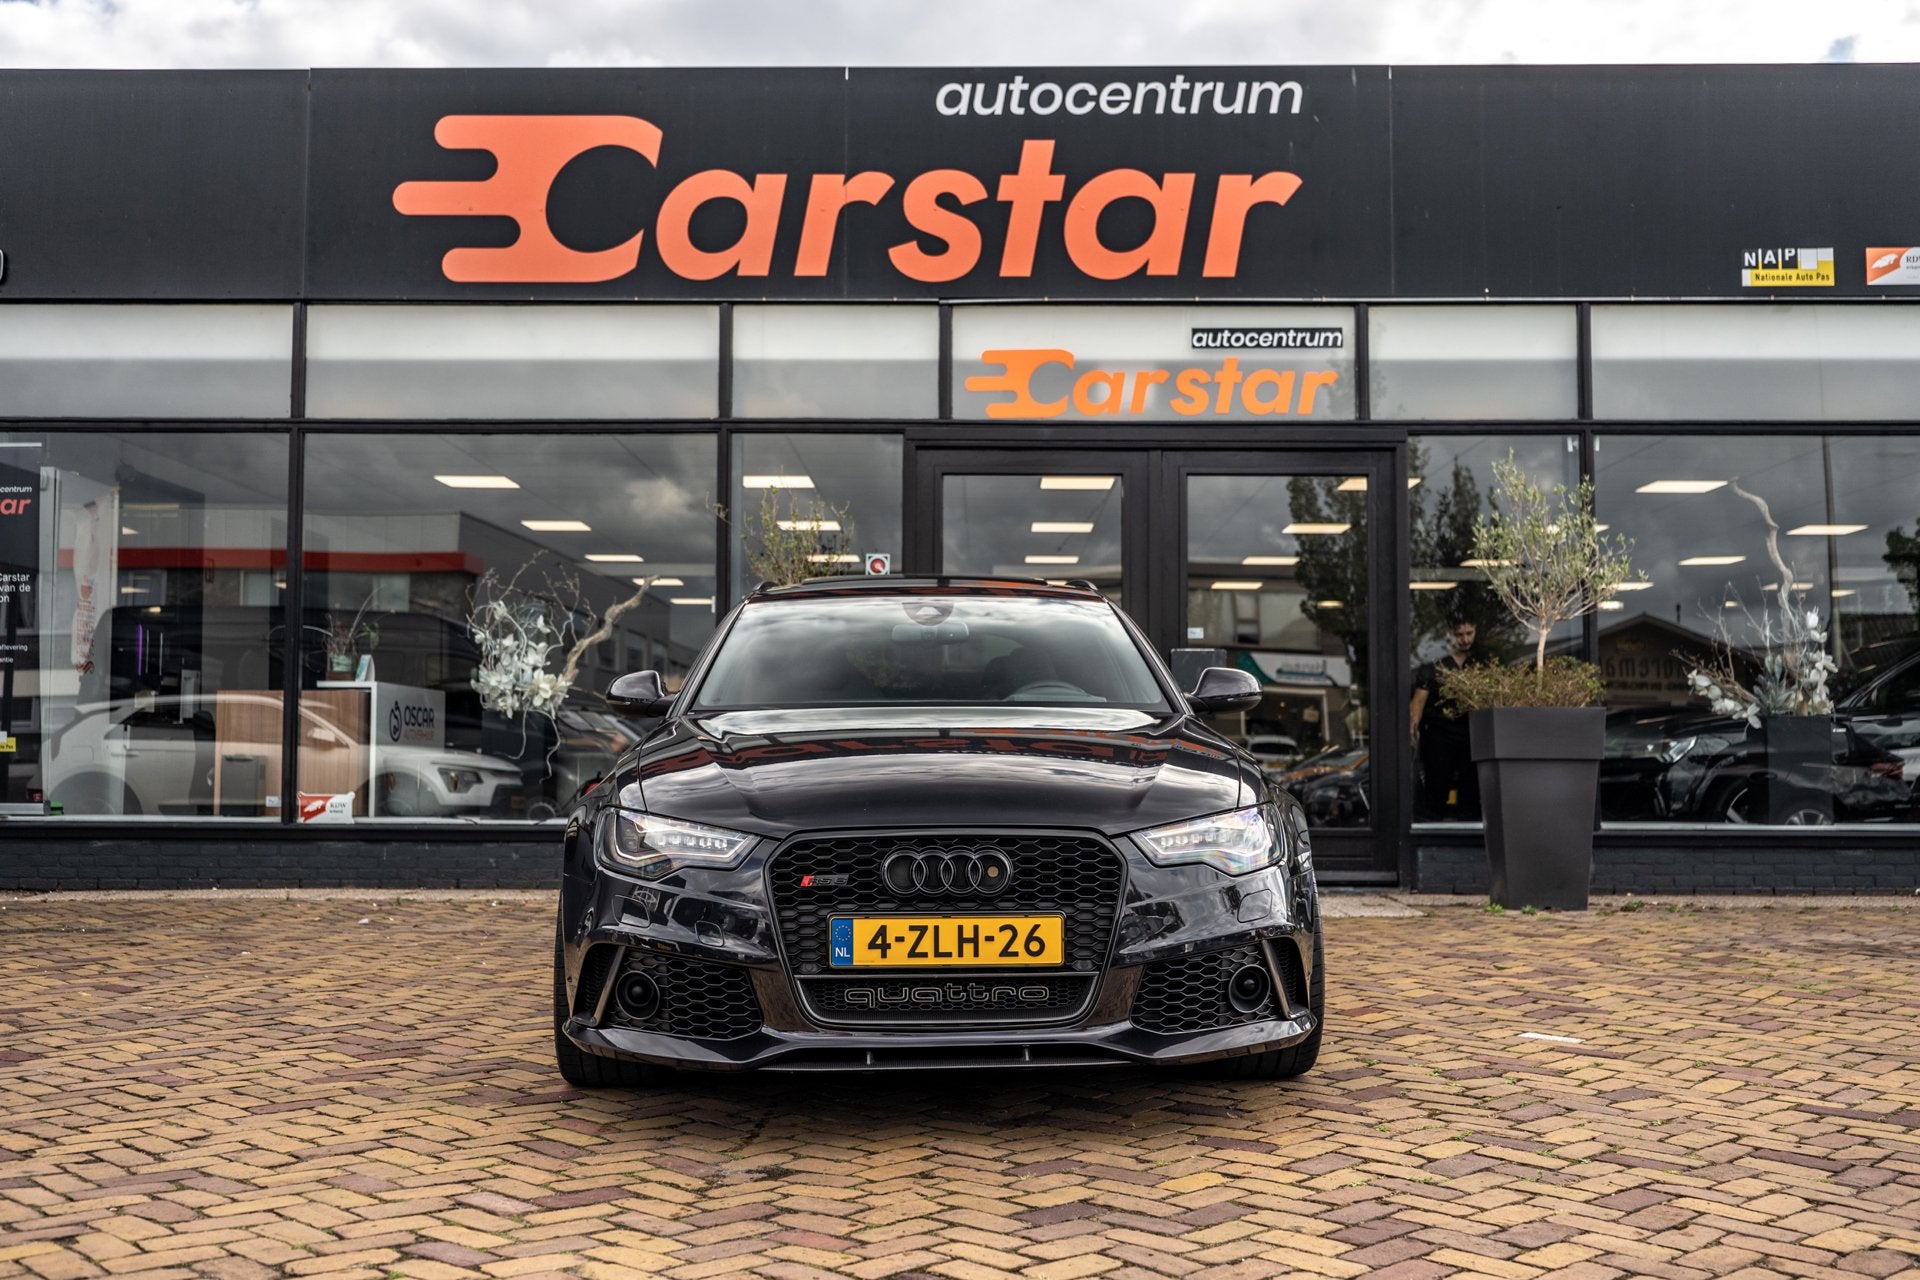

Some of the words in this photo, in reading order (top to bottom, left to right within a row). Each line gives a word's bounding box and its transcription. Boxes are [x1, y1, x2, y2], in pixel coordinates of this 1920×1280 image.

[935, 75, 1303, 116] autocentrum
[393, 114, 1303, 283] Carstar
[1755, 273, 1793, 281] Nationale
[1796, 273, 1813, 281] Auto
[1816, 272, 1830, 281] Pas
[1192, 329, 1342, 348] autocentrum
[964, 349, 1339, 419] Carstar
[19, 583, 31, 592] de
[404, 706, 435, 728] OSCAR
[835, 946, 850, 958] NL
[867, 924, 1046, 959] 4-ZLH-26
[844, 983, 1050, 1008] quattro
